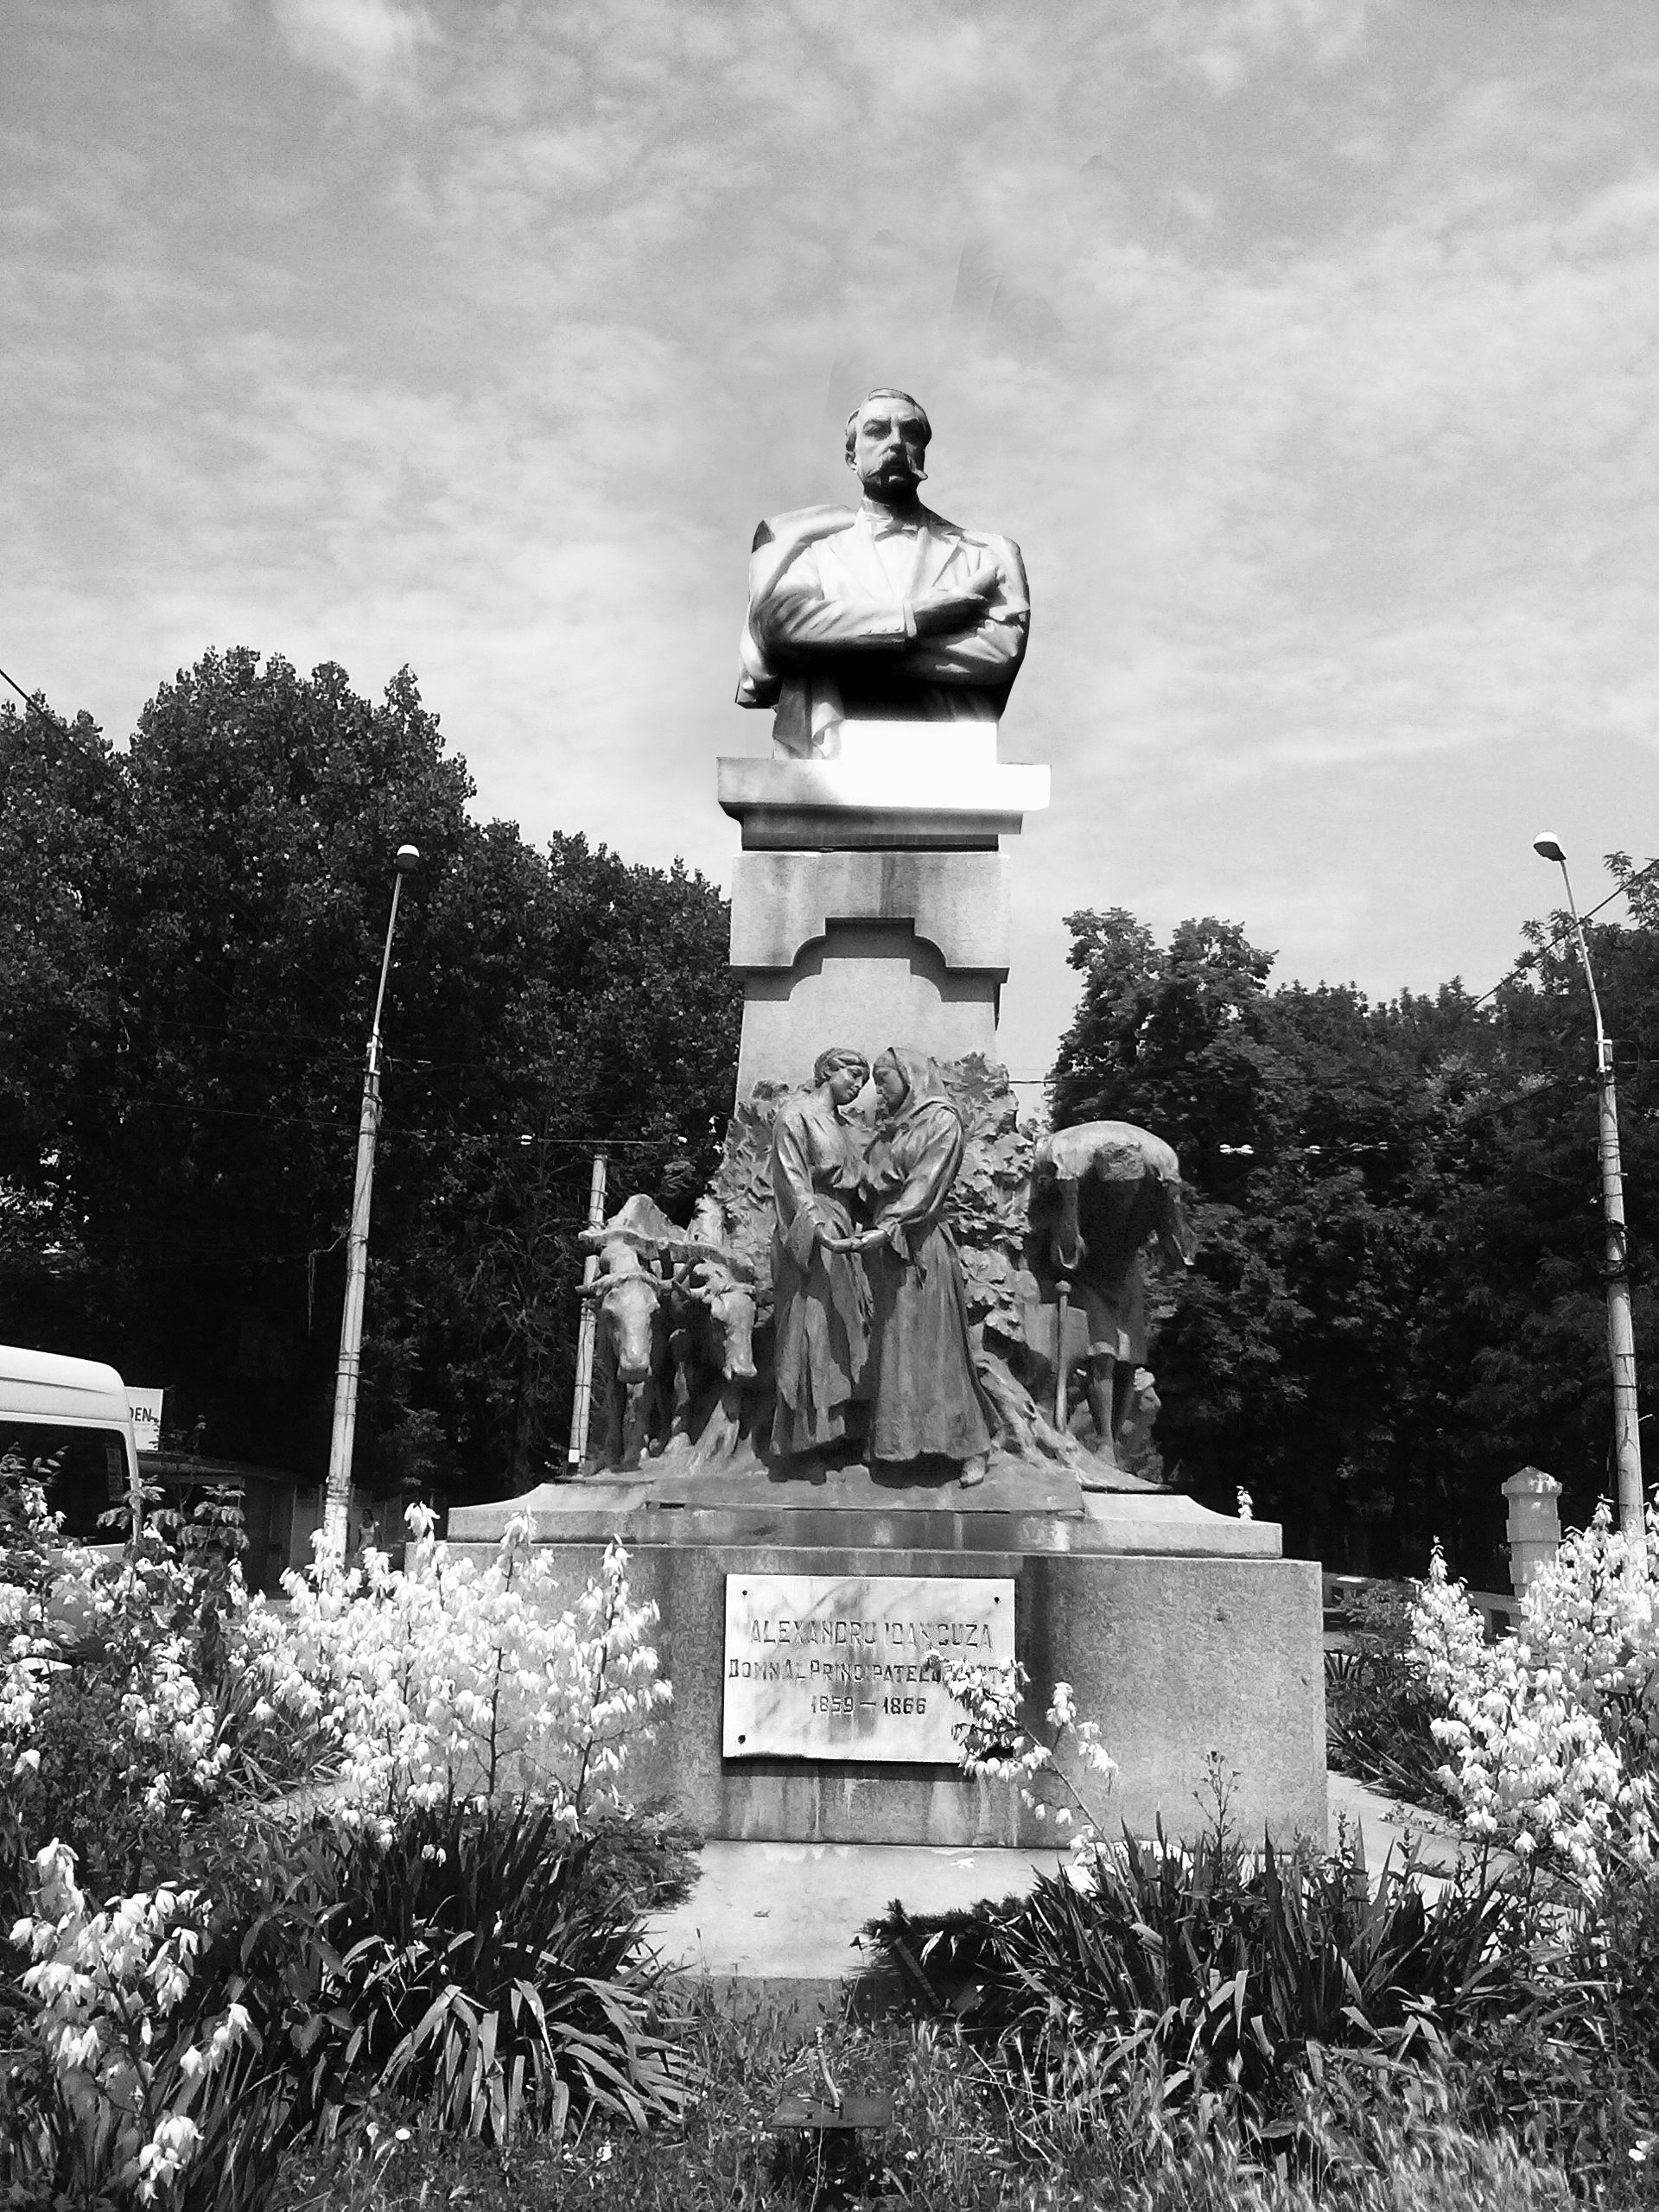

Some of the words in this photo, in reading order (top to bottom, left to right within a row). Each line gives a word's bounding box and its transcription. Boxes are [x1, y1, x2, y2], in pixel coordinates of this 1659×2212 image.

[751, 1619, 876, 1646] ALEXANDRU
[938, 1623, 993, 1649] CUZA
[728, 1658, 779, 1681] DOMN
[781, 1658, 807, 1680] AL
[810, 1694, 854, 1713] 1859
[883, 1696, 927, 1715] 1866
